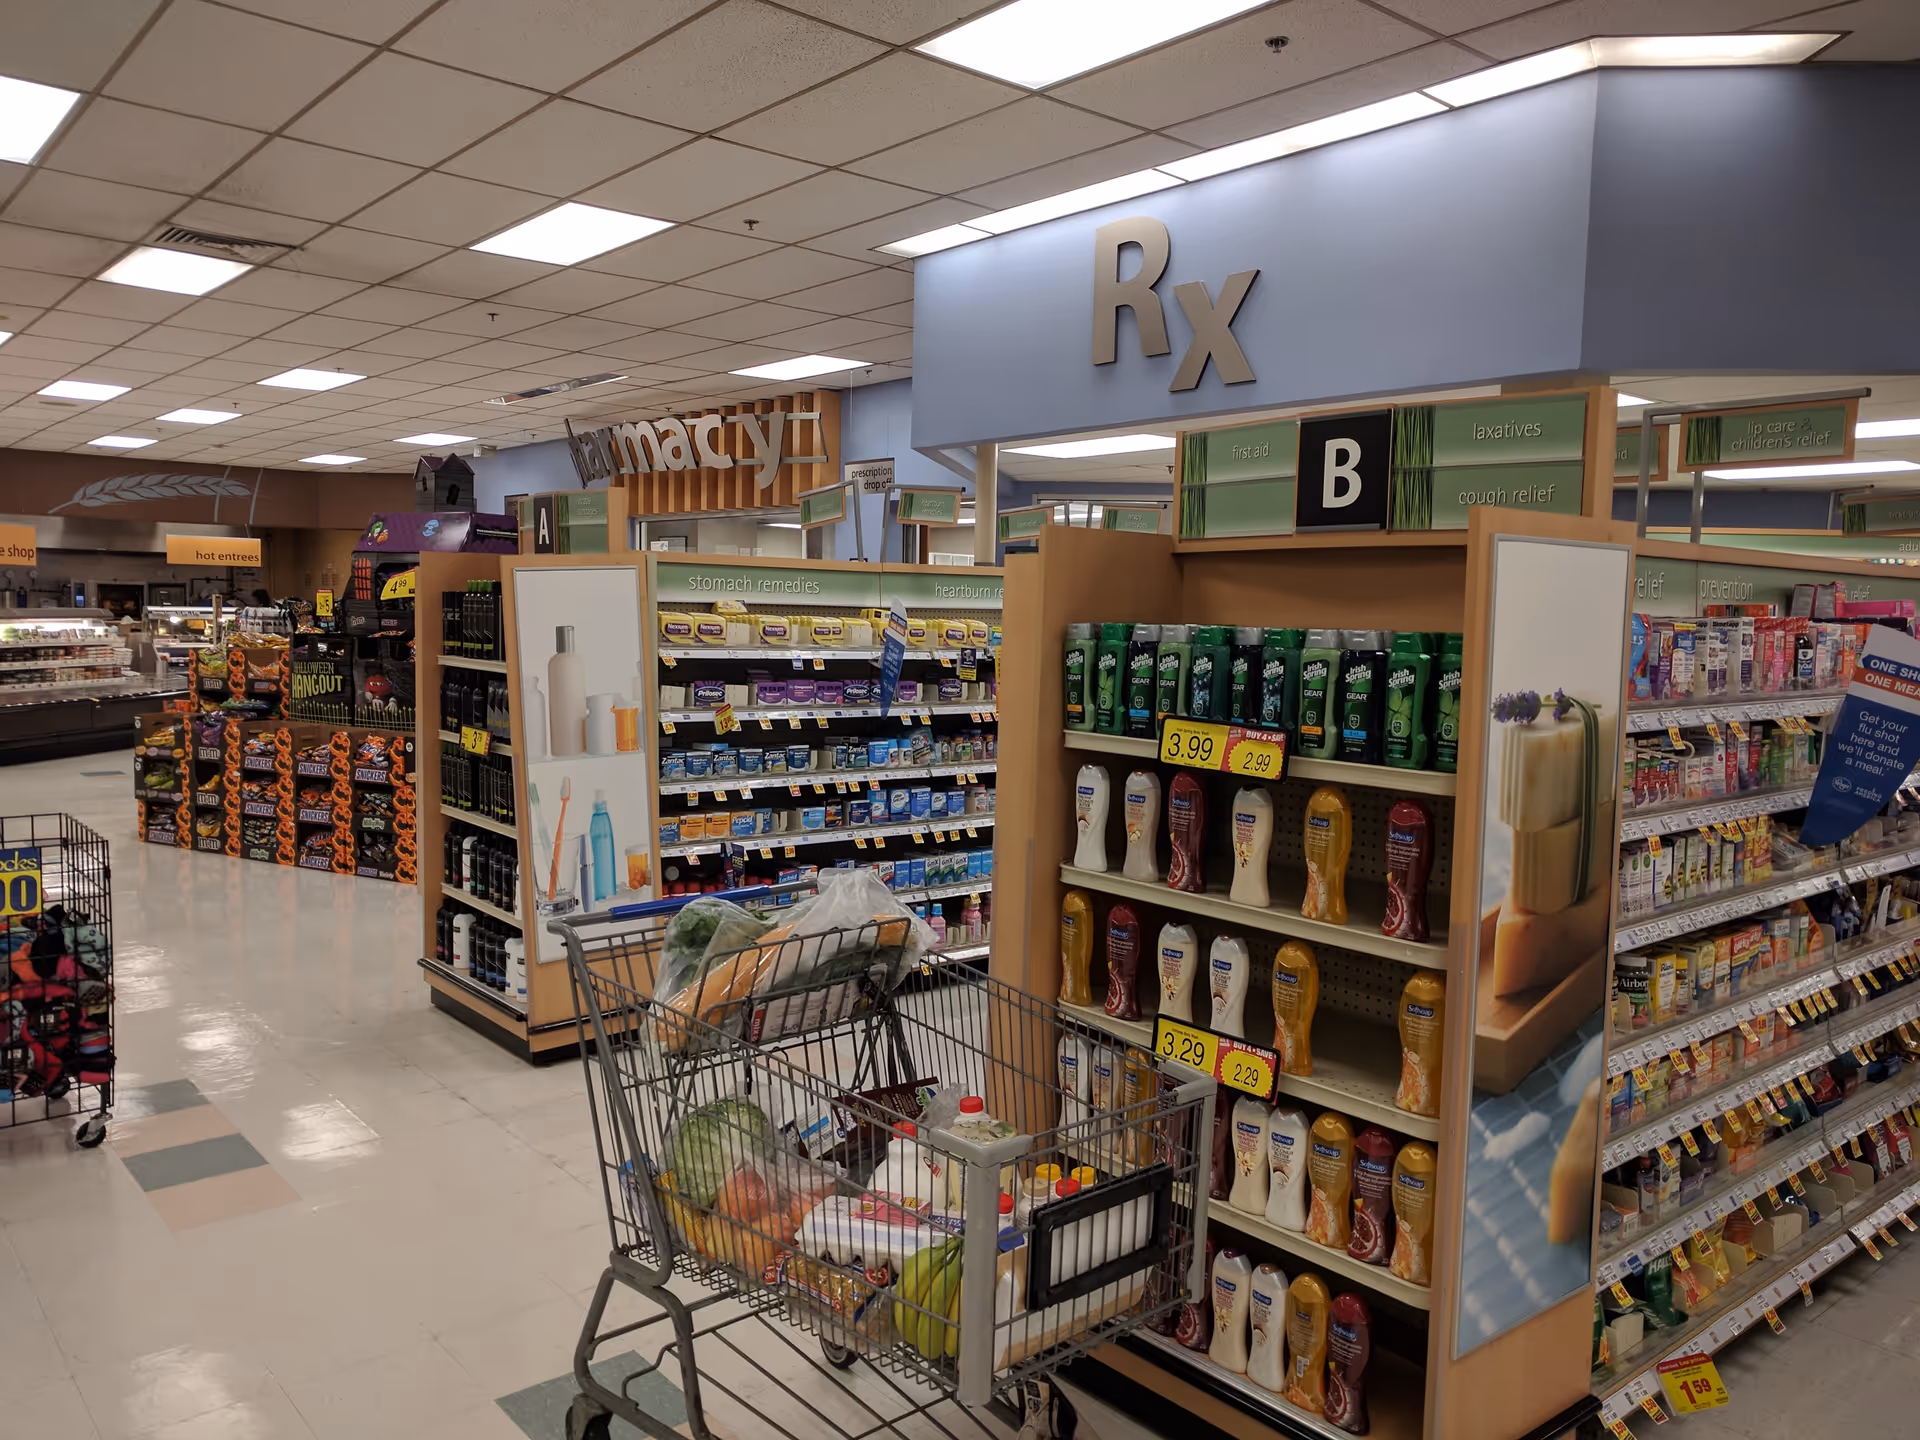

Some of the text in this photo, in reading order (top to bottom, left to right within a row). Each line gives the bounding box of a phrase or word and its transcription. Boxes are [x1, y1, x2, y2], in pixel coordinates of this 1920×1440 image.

[1092, 216, 1261, 392] Rx
[1472, 420, 1542, 440] laxatives
[1748, 418, 1813, 437] lip care &
[1731, 430, 1831, 451] children's relief
[1232, 441, 1270, 460] first aid
[851, 465, 893, 480] prescription
[1322, 437, 1363, 509] B
[863, 479, 881, 492] drop
[1458, 483, 1555, 508] cough relief
[538, 507, 550, 545] A
[7, 544, 35, 561] shop
[195, 550, 260, 562] hot entrees
[688, 573, 821, 594] stomach remedies
[935, 582, 992, 599] heartburn
[1700, 575, 1753, 601] prevention
[1066, 654, 1084, 667] Spring
[1068, 651, 1080, 660] Irish
[1100, 653, 1112, 662] Irish
[1134, 653, 1149, 662] Irish
[1161, 655, 1175, 664] Irish
[1195, 656, 1208, 666] Irish
[1233, 657, 1244, 666] Irish
[1099, 657, 1116, 669] Spring
[1130, 657, 1153, 670] Spring
[1159, 659, 1179, 672] Spring
[1193, 661, 1213, 674] Spring
[1232, 662, 1248, 675] Spring
[1265, 660, 1280, 670] Irish
[1307, 662, 1323, 672] Irish
[1350, 664, 1367, 674] Irish
[1870, 659, 1898, 674] ONE
[1262, 665, 1284, 679] Spring
[1303, 666, 1328, 681] Spring
[1345, 669, 1372, 684] Spring
[1392, 668, 1410, 679] Irish
[1443, 670, 1461, 682] Irish
[291, 673, 344, 699] HANGOUT
[1388, 673, 1415, 689] Spring
[1865, 673, 1892, 689] ONE
[697, 690, 723, 698] Prilosec
[846, 687, 868, 695] Prilosec
[1304, 689, 1323, 698] GEAR
[1346, 692, 1367, 701] GEAR
[1859, 710, 1909, 734] Get your
[1246, 730, 1261, 740] BUY
[1261, 732, 1268, 741] 4
[1858, 722, 1901, 744] flu shot
[1167, 732, 1214, 762] 3.99
[1850, 732, 1900, 757] here and
[661, 756, 685, 765] Zantac
[713, 754, 737, 762] Zantac
[764, 752, 786, 760] Zantac
[1242, 752, 1271, 773] 2.99
[1838, 742, 1905, 771] we'll donate
[1845, 757, 1853, 766] a
[245, 756, 273, 771] SNICKERS
[298, 762, 328, 776] SNICKERS
[355, 768, 387, 783] SNICKERS
[245, 802, 274, 817] SNICKERS
[300, 809, 329, 823] SNICKERS
[732, 814, 753, 824] Pepcid
[1236, 813, 1255, 823] Softsoap
[1309, 817, 1329, 827] Softsoap
[1389, 831, 1413, 841] Softsoap
[300, 856, 330, 870] SNICKERS
[732, 855, 744, 867] FREE
[1162, 948, 1183, 958] Softsoap
[1212, 959, 1232, 970] Softsoap
[1275, 971, 1298, 984] Softsoap
[1407, 1004, 1434, 1018] Softsoap
[1162, 1031, 1206, 1066] 3.29
[1233, 1041, 1247, 1051] BUY
[1256, 1048, 1273, 1060] SAVE
[1233, 1063, 1259, 1088] 2.29
[1237, 1121, 1260, 1134] Softsoap
[1271, 1132, 1294, 1145] Softsoap
[1313, 1143, 1341, 1158] Softsoap
[1359, 1159, 1386, 1172] Softsoap
[1399, 1174, 1424, 1189] Softsoap
[1215, 1277, 1236, 1291] Softsoap
[1252, 1290, 1272, 1305] Softsoap
[1332, 1324, 1357, 1341] Softsoap
